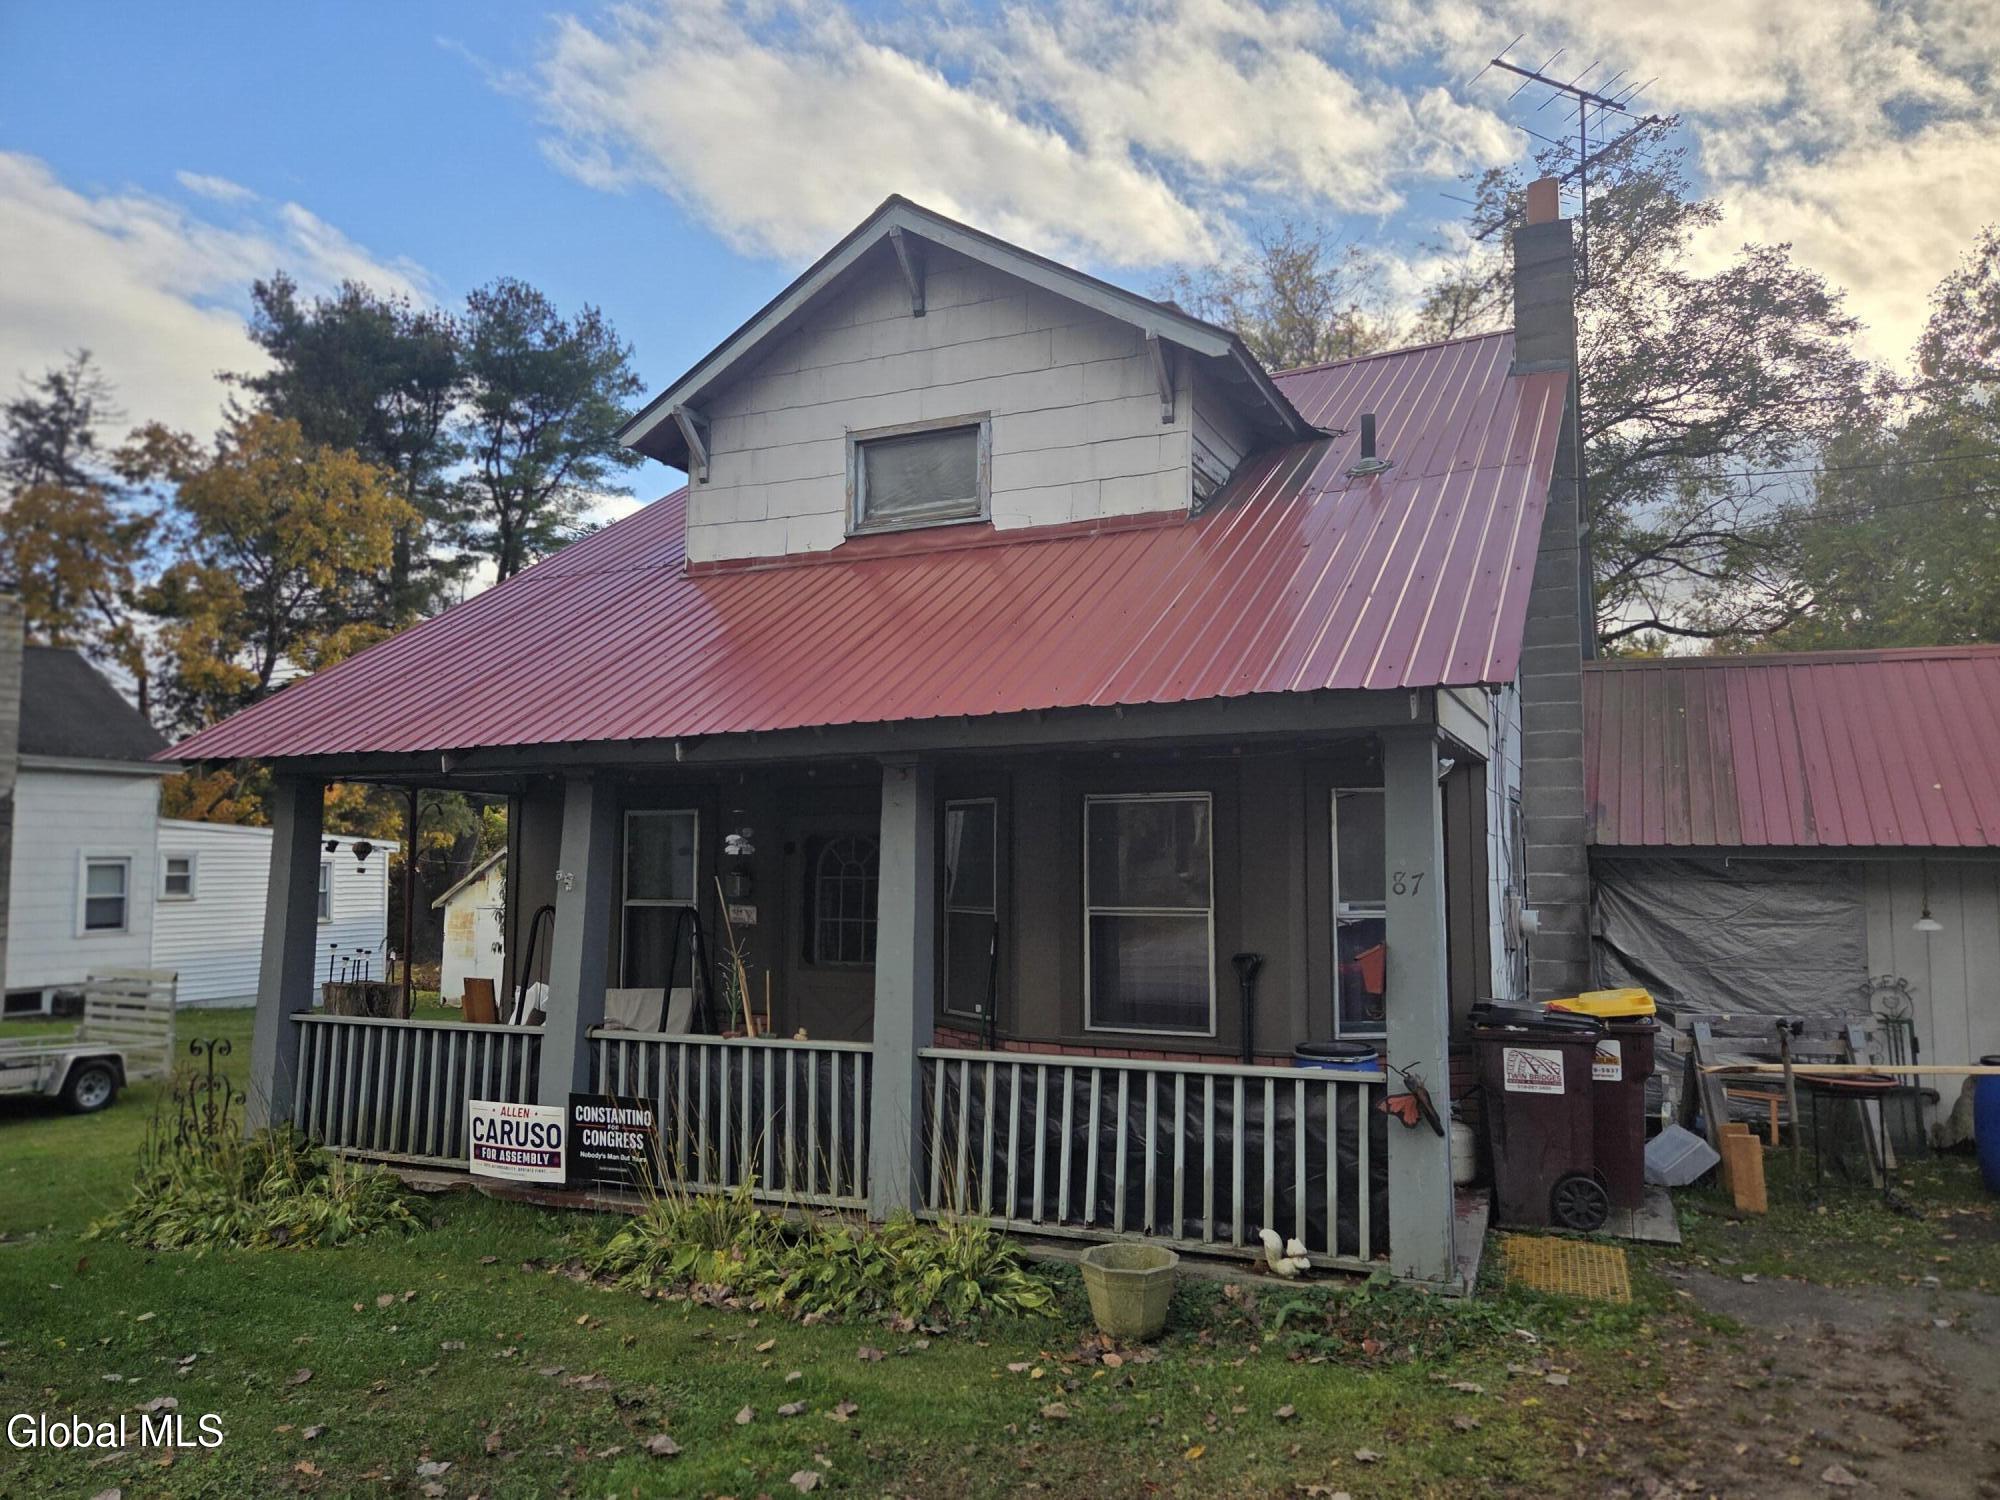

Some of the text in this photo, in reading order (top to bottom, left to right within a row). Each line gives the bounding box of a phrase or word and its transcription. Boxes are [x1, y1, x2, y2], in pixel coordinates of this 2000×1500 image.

[1392, 871, 1425, 897] 87
[1507, 1072, 1561, 1082] TWIN BRIDGES
[500, 1106, 530, 1119] ALLEN
[575, 1105, 652, 1127] CONSTANTINO
[473, 1116, 562, 1149] CARUSO
[582, 1129, 644, 1150] CONGRESS
[481, 1147, 550, 1165] FOR ASSEMBLY
